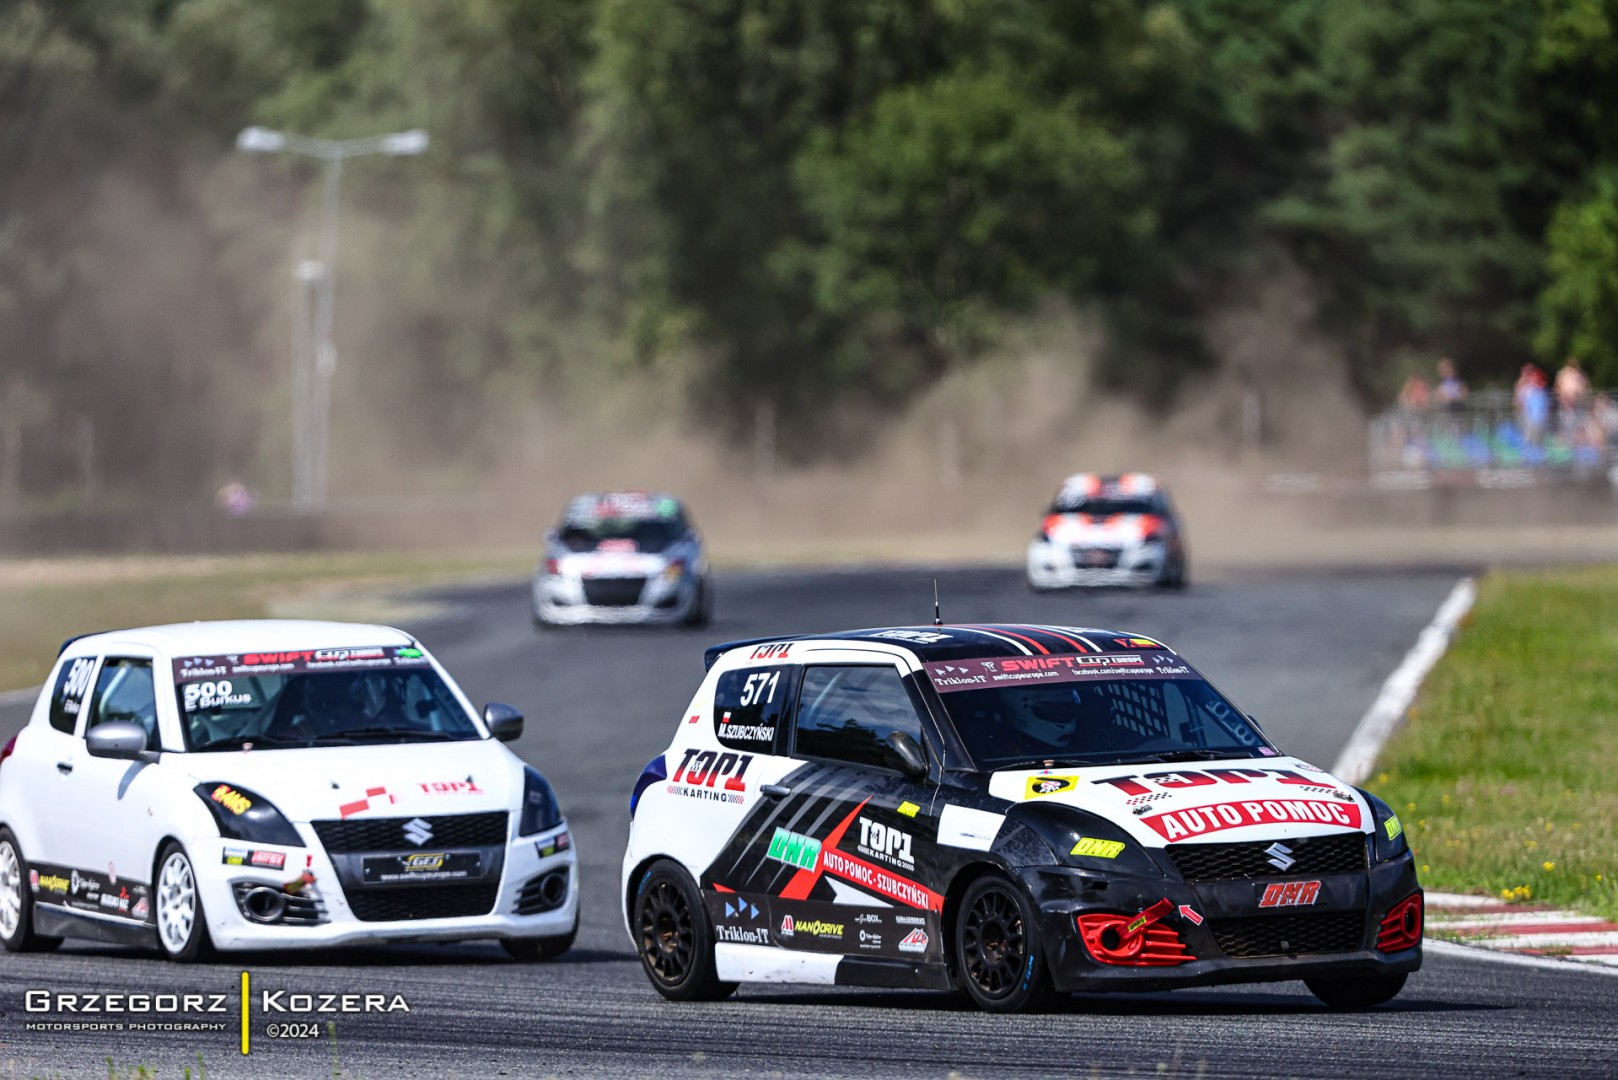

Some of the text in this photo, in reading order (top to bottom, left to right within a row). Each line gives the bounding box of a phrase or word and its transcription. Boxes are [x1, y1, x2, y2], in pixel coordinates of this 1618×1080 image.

[243, 650, 314, 665] SWIFT
[1001, 656, 1075, 672] SWIFT
[1111, 655, 1144, 664] EUROPE
[64, 657, 96, 698] 500
[934, 674, 988, 686] Triklon-IT
[992, 670, 1060, 682] swiftcupeurope.com
[184, 680, 232, 701] 500
[740, 670, 781, 707] 571
[717, 722, 775, 742] M.SZUBCZYŃSKI
[672, 748, 754, 792] TOP1
[683, 787, 727, 803] KARTING
[1161, 800, 1351, 840] AUTO POMOC
[766, 826, 822, 873] DNR
[859, 816, 915, 864] TOP1
[1069, 837, 1126, 859] DNR
[868, 848, 903, 868] KARTING
[823, 850, 844, 872] AUTO
[844, 858, 873, 885] POMOC
[877, 872, 929, 910] SZUBCZYŃSKI
[1258, 880, 1321, 908] DNR
[715, 924, 768, 944] Triklon-IT
[794, 920, 844, 936] NANODRIVE
